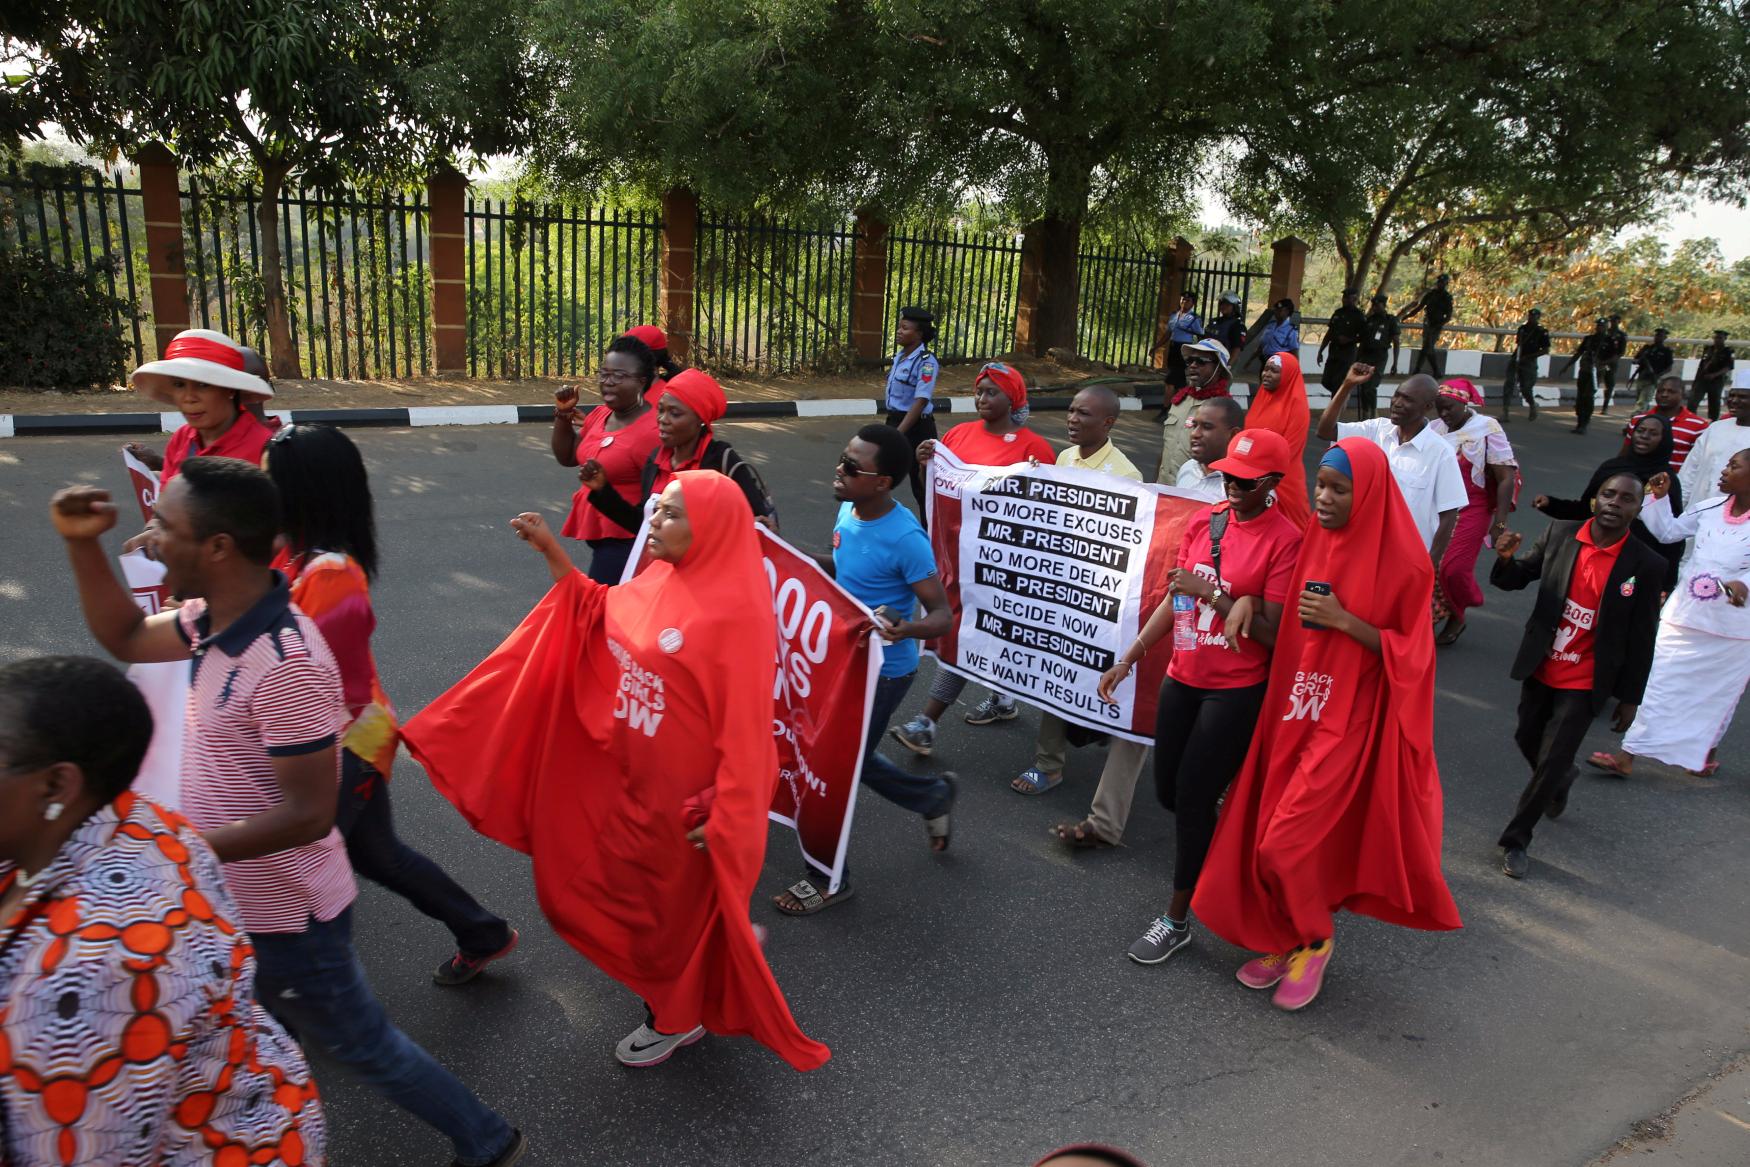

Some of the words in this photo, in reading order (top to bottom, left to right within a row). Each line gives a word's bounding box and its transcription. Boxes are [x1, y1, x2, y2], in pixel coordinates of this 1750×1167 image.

[989, 478, 1023, 495] MR.
[1029, 483, 1131, 515] PRESIDENT
[972, 498, 999, 513] NO
[1003, 503, 1058, 525] MORE
[1063, 513, 1142, 545] EXCUSES
[986, 522, 1016, 542] MR.
[1022, 529, 1124, 566] PRESIDENT
[979, 545, 1002, 563] NO
[1008, 552, 1064, 576] MORE
[1069, 565, 1122, 593] DELAY
[982, 568, 1011, 588] MR.
[1016, 577, 1113, 616] PRESIDENT
[993, 595, 1056, 625] DECIDE
[1062, 614, 1098, 639] NOW
[982, 614, 1006, 637] MR.
[1011, 625, 1107, 668] PRESIDENT
[966, 651, 988, 671] WE
[992, 661, 1039, 689] WANT
[1044, 680, 1121, 720] RESULTS
[1000, 647, 1036, 668] ACT
[1041, 658, 1078, 684] NOW
[621, 672, 665, 711] GIRLS
